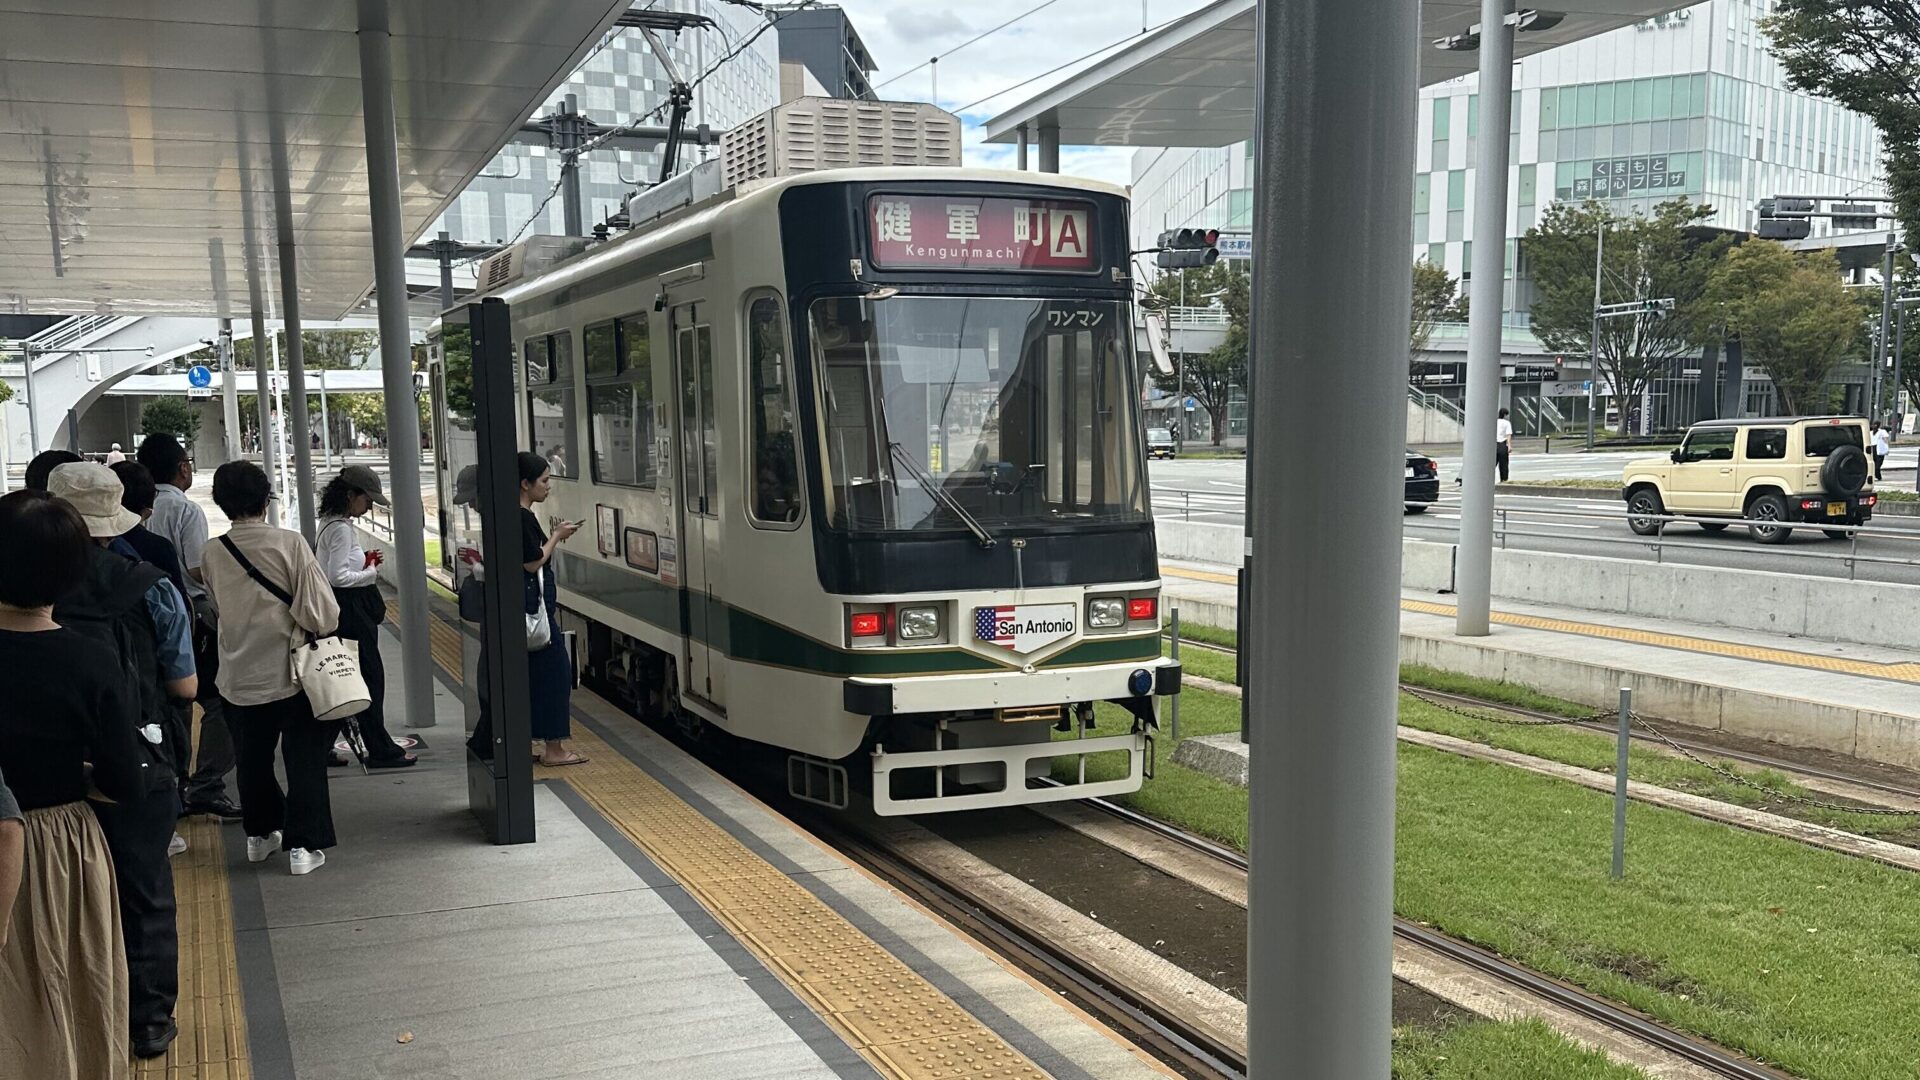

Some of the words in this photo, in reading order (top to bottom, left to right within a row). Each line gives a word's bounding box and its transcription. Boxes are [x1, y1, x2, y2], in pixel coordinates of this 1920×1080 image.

[1596, 159, 1664, 175] くまもと
[875, 201, 1047, 246] 健軍町
[1055, 214, 1082, 253] A
[905, 244, 1021, 259] Kengunmachi
[1047, 310, 1104, 327] ワンマン
[999, 621, 1023, 635] San
[1025, 618, 1073, 634] Antonio
[315, 661, 326, 672] LE
